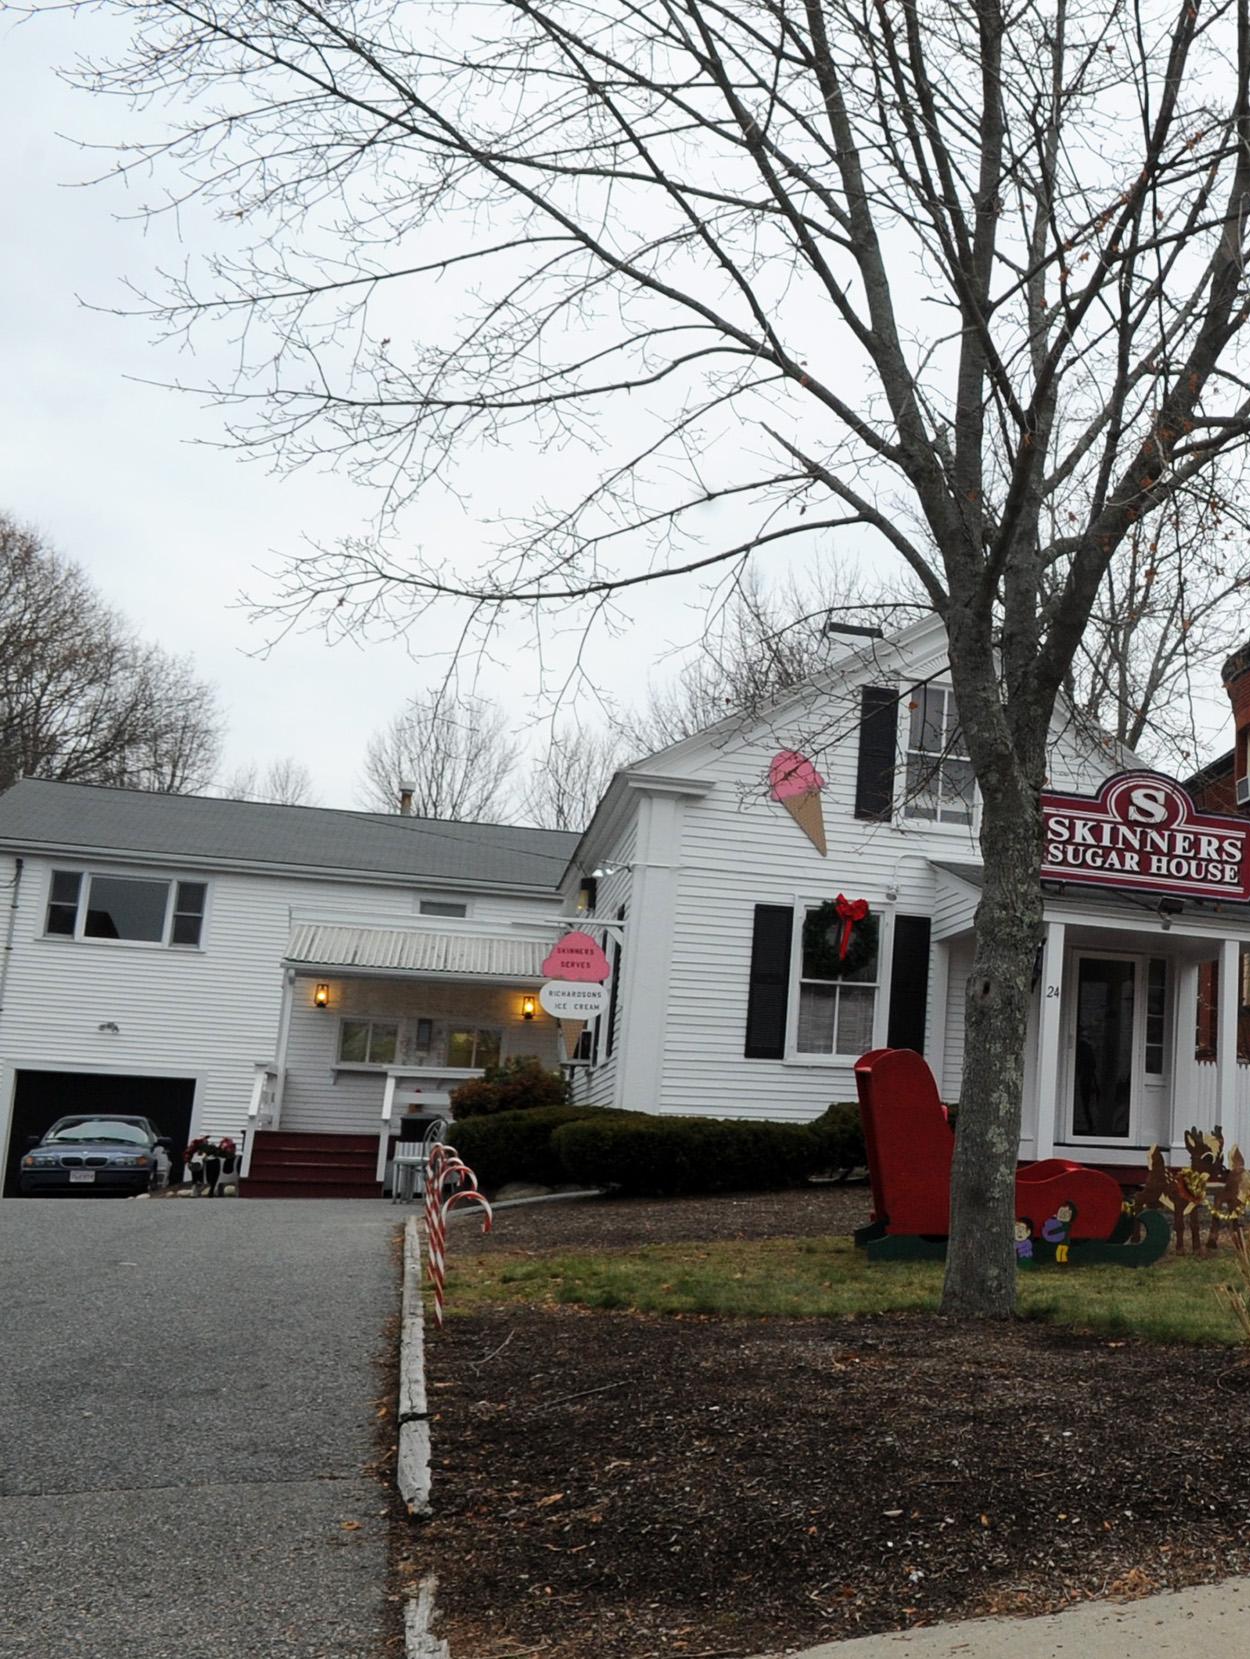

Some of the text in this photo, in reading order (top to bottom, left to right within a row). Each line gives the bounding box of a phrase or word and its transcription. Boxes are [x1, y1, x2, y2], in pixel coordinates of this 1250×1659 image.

[1128, 788, 1168, 824] S
[1047, 817, 1242, 863] SKINNERS
[1048, 844, 1239, 884] SUGAR HOUSE
[560, 961, 591, 969] SERVES
[548, 990, 602, 998] RICHARDSONS
[1046, 985, 1060, 999] 24
[574, 1003, 600, 1011] CREAM
